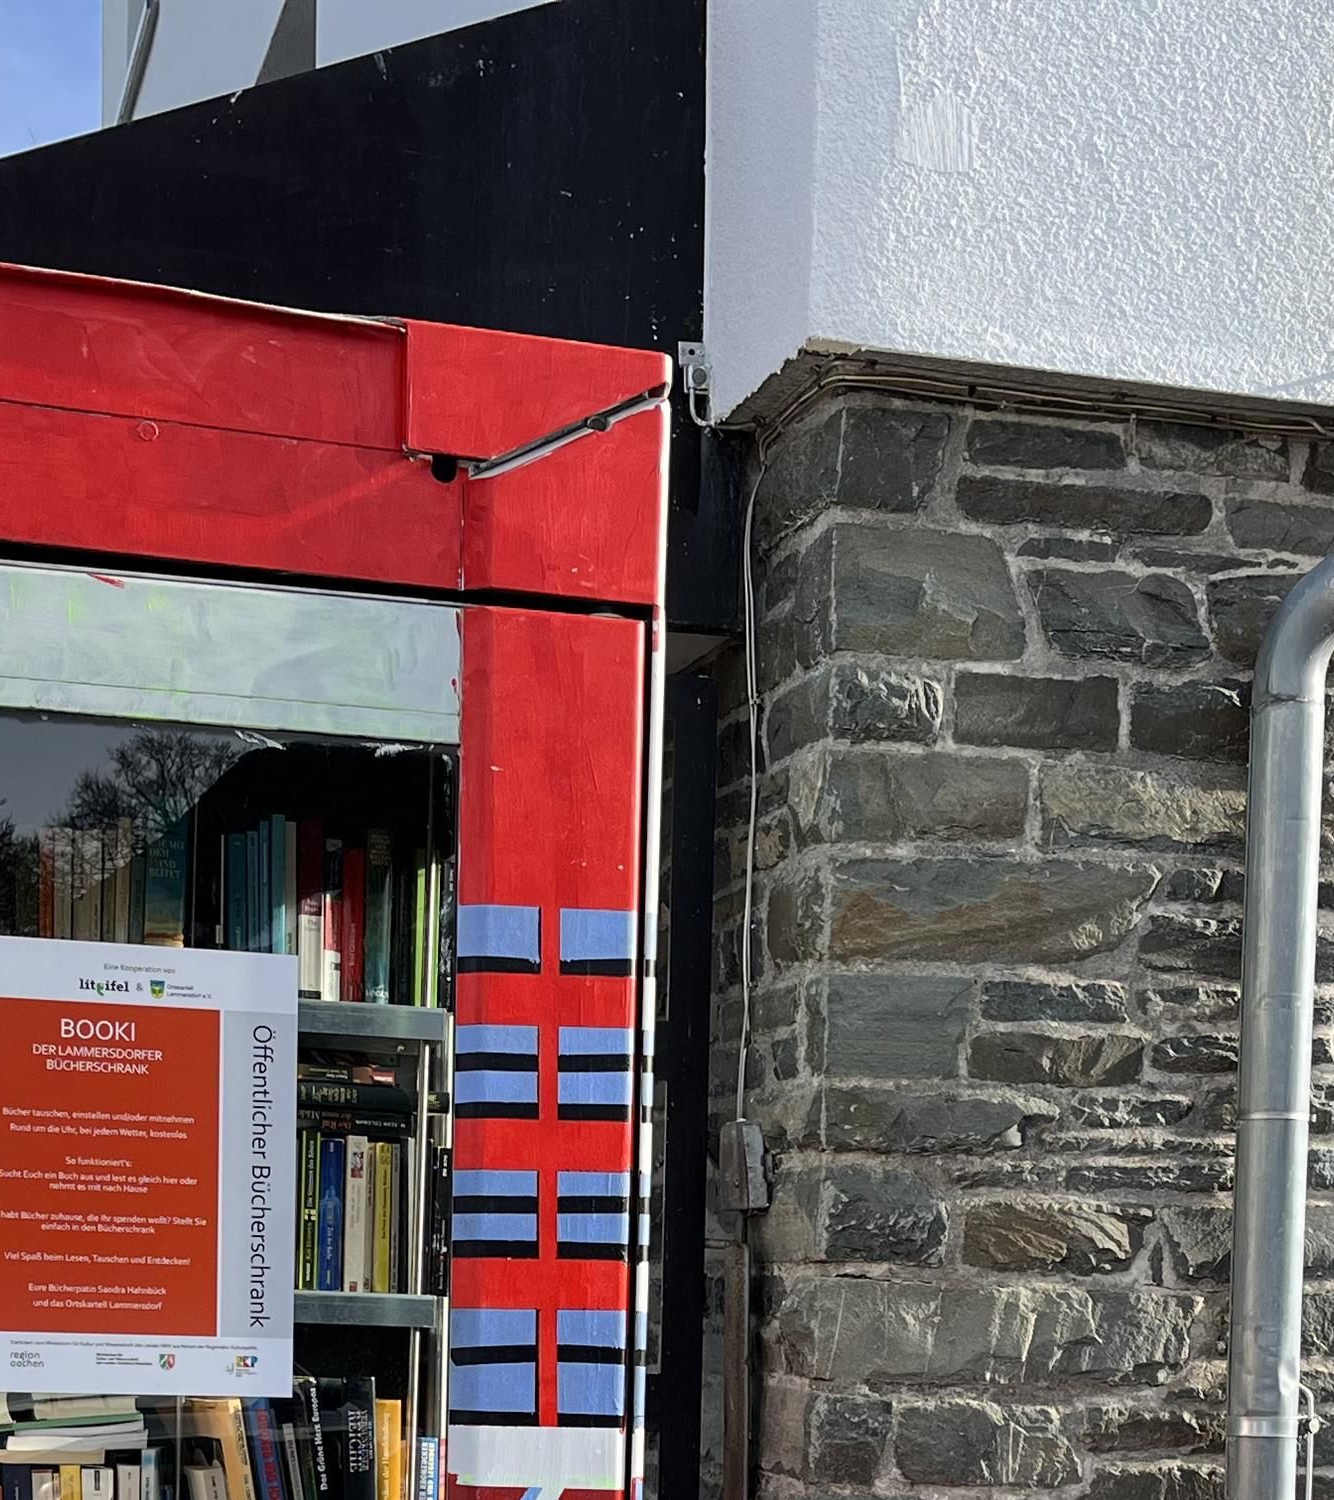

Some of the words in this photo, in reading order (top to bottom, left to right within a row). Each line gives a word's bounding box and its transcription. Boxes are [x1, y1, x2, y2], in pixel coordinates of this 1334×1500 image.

[104, 962, 118, 970] Eine
[120, 964, 162, 974] Kooperation
[136, 982, 144, 992] &
[60, 1018, 135, 1041] BOOKI
[32, 1043, 56, 1055] DER
[58, 1045, 162, 1061] LAMMERSDORFER
[46, 1058, 148, 1074] BÜCHERSCHRANK
[252, 1024, 276, 1160] Öffentlicher
[2, 1107, 31, 1116] Bücher
[32, 1109, 70, 1119] tauschen,
[72, 1111, 110, 1119] einstellen
[149, 1115, 194, 1123] mitnehmen
[10, 1122, 31, 1131] Rund
[47, 1124, 60, 1133] die
[61, 1125, 78, 1135] Uhr,
[79, 1126, 92, 1134] bei
[92, 1127, 118, 1136] jedem
[119, 1128, 148, 1138] Wetter,
[150, 1129, 187, 1138] kostenlos
[65, 1156, 76, 1164] So
[23, 1170, 43, 1178] Euch
[58, 1171, 78, 1180] Buch
[112, 1174, 126, 1182] lest
[138, 1175, 162, 1185] gleich
[163, 1176, 178, 1184] hier
[179, 1177, 197, 1185] oder
[49, 1181, 76, 1190] nehmt
[123, 1184, 147, 1193] Hause
[0, 1210, 19, 1218] habt
[20, 1211, 49, 1220] Bücher
[50, 1212, 85, 1222] zuhause,
[86, 1214, 99, 1222] die
[113, 1215, 146, 1223] spenden
[147, 1216, 171, 1224] wollt?
[172, 1216, 193, 1225] Stellt
[194, 1217, 206, 1226] Sie
[41, 1222, 70, 1230] einfach
[97, 1224, 155, 1233] Bücherschrank
[250, 1164, 272, 1328] Bücherschrank
[20, 1252, 42, 1261] Spaß
[43, 1252, 64, 1260] beim
[65, 1254, 91, 1263] Lesen,
[92, 1254, 129, 1263] Tauschen
[147, 1256, 190, 1265] Entdecken!
[28, 1283, 47, 1291] Eure
[97, 1285, 125, 1293] Sandra
[32, 1299, 48, 1307] und
[109, 1301, 162, 1309] Lammersdorf
[10, 1351, 40, 1360] region
[10, 1360, 44, 1368] aachen
[310, 1388, 320, 1421] Europas
[314, 1422, 323, 1444] Herz
[348, 1410, 362, 1472] REICHE
[316, 1445, 326, 1472] Grüne
[320, 1474, 328, 1490] Das
[426, 1480, 434, 1495] UND
